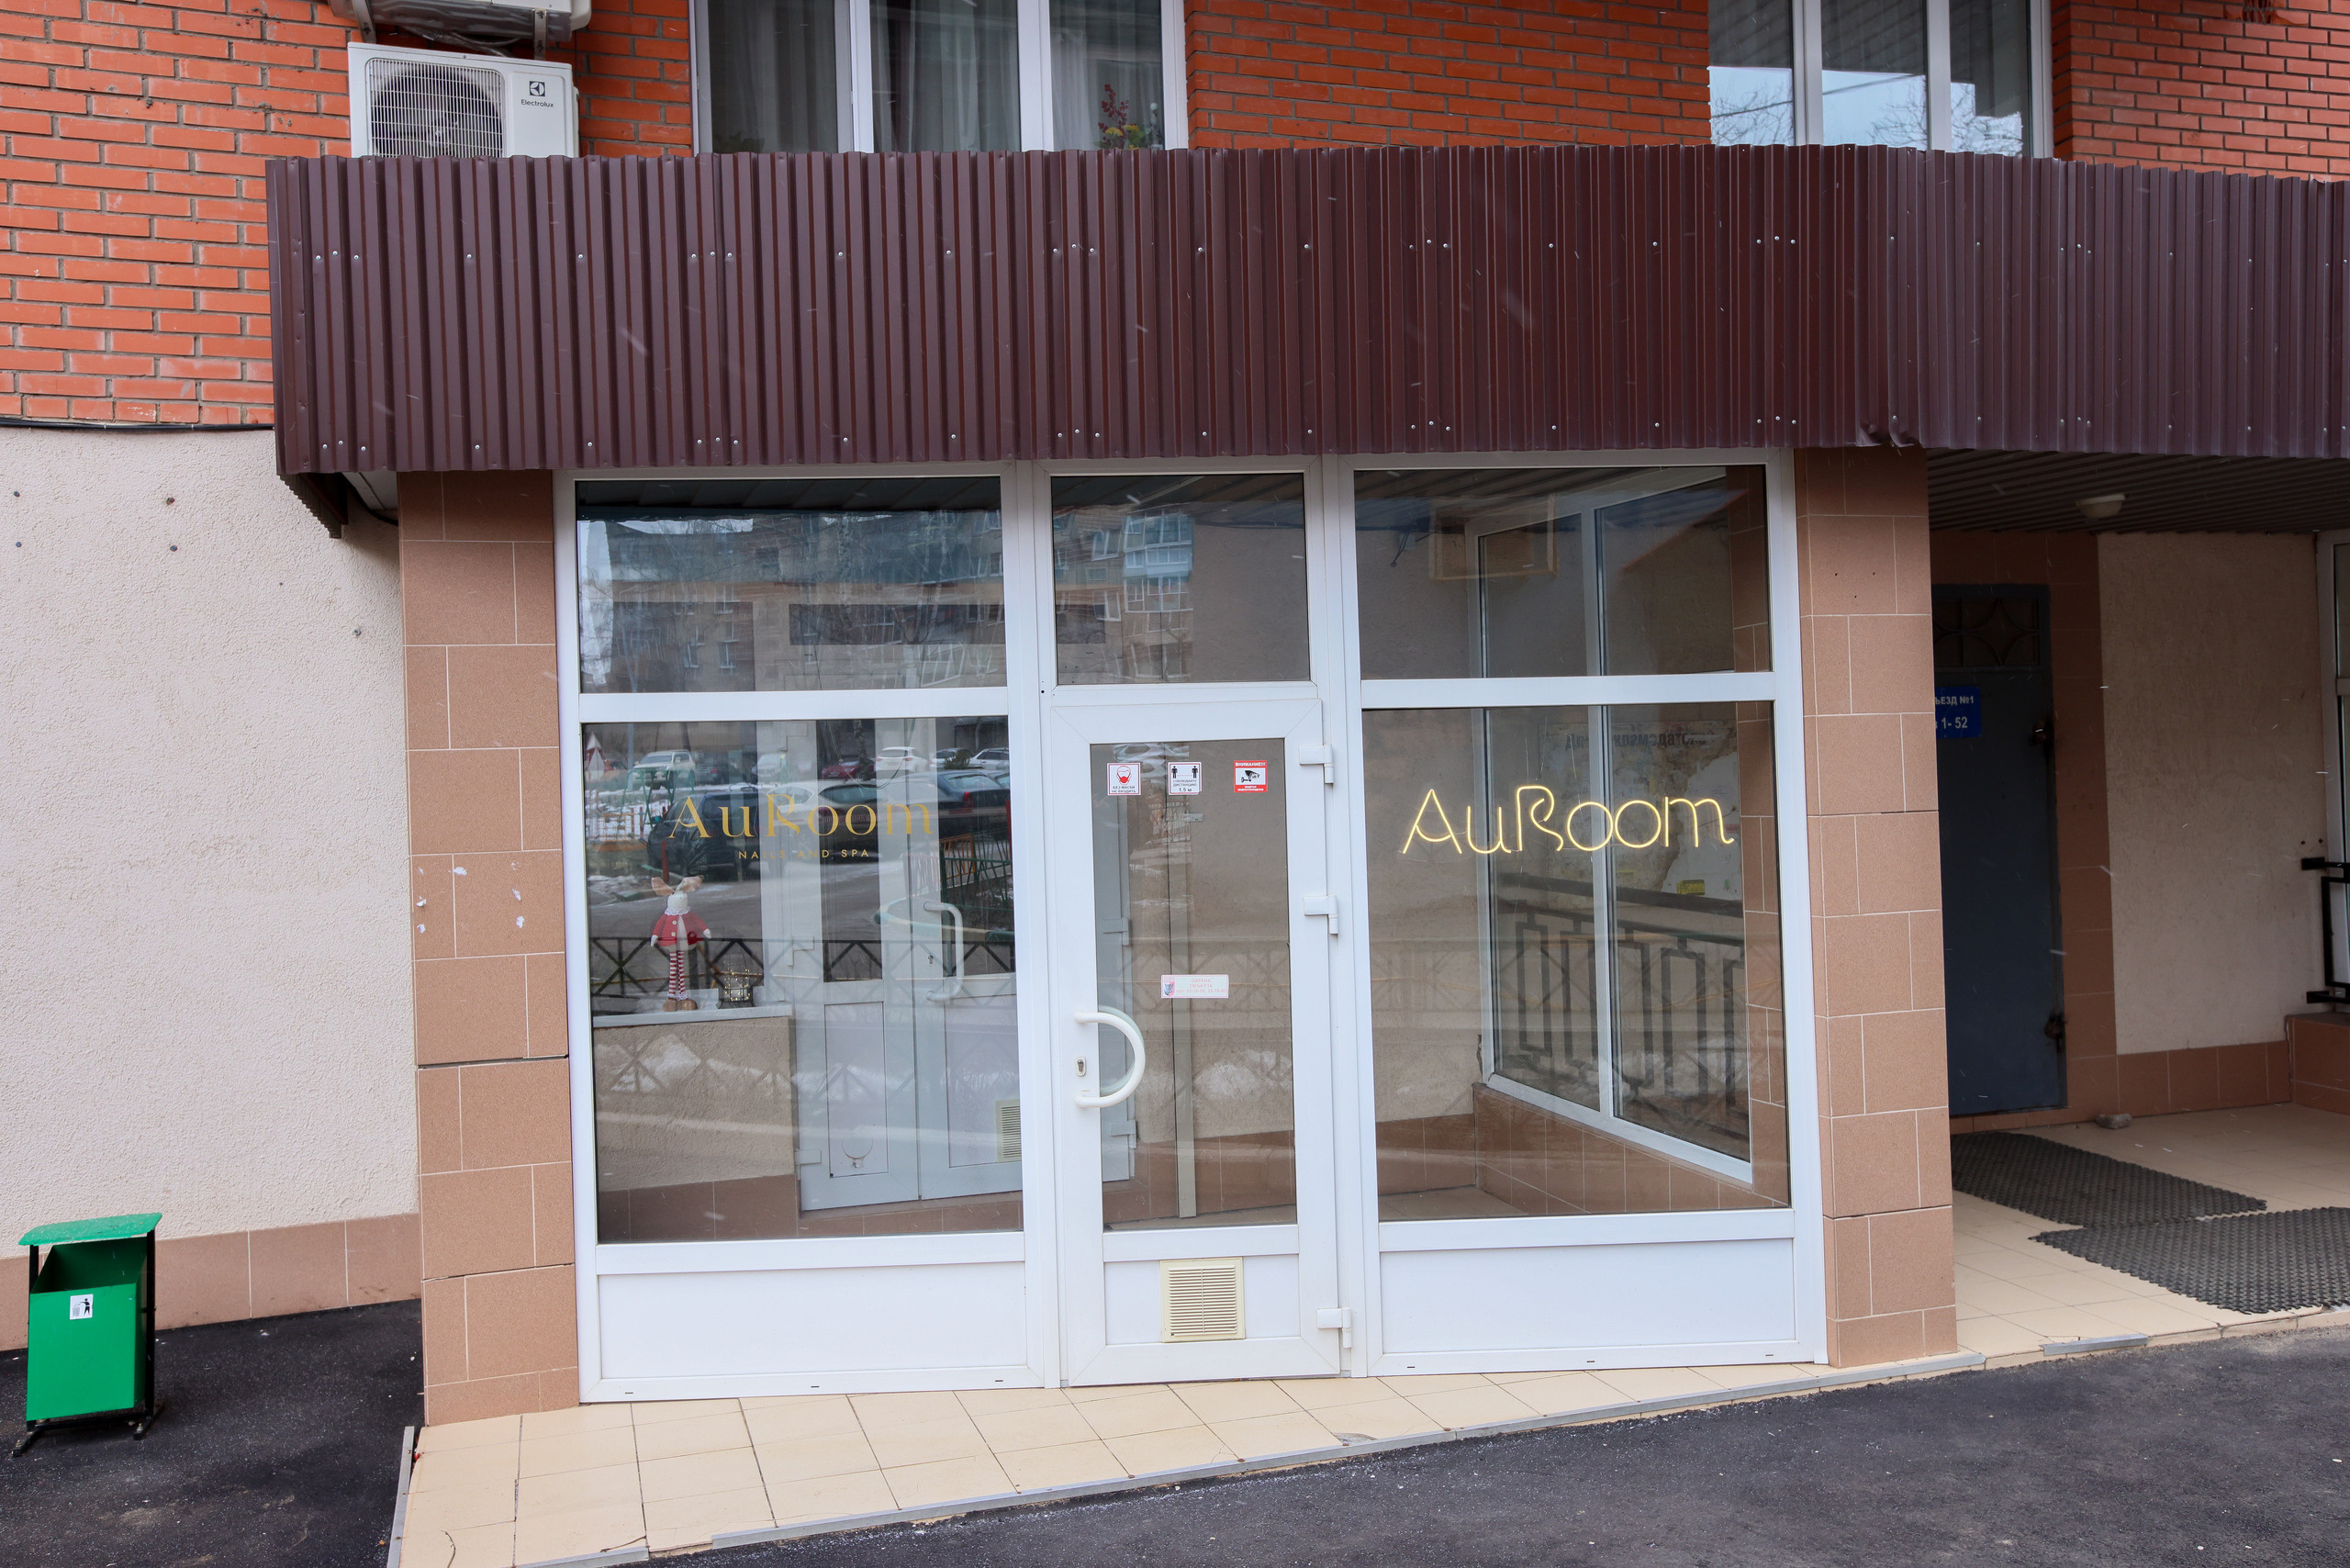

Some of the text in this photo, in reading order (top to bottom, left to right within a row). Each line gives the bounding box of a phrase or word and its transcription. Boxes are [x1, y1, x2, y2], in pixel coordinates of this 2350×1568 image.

[520, 98, 554, 108] Electrolux
[1934, 695, 1975, 705] ЪЕЗД №1
[1954, 716, 1968, 729] 52
[666, 793, 934, 839] AuRoom
[1403, 785, 1735, 854] AuRoom
[738, 848, 869, 859] NAILS AND SPA
